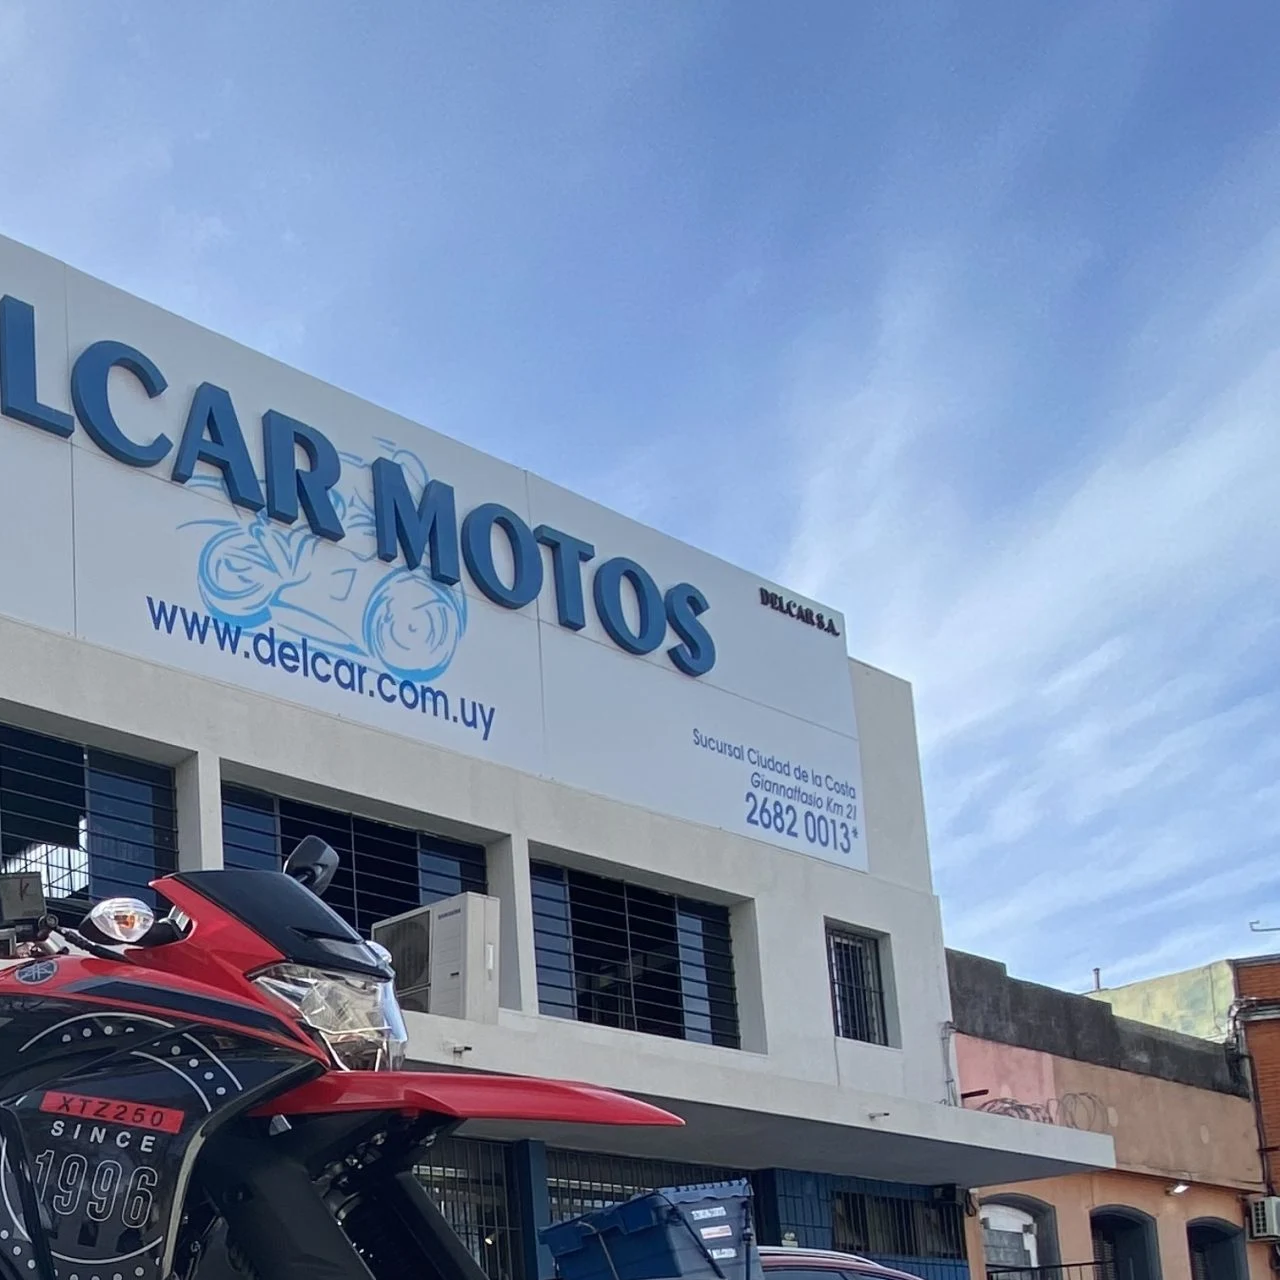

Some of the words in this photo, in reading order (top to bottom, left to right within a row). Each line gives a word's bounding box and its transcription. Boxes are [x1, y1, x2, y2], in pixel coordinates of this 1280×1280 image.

[370, 457, 717, 677] MOTOS
[759, 587, 816, 627] DELCAR
[147, 594, 497, 741] www.delcar.com.uy
[692, 727, 745, 762] Sucursal
[747, 748, 791, 777] Ciudad
[793, 764, 809, 784] de
[811, 769, 822, 788] la
[824, 775, 856, 799] Costa
[745, 791, 799, 838] 2682
[750, 772, 823, 810] Giannattasio
[826, 797, 844, 816] Km
[846, 804, 857, 821] 21
[50, 1120, 157, 1153] SINCE
[57, 1096, 165, 1128] XTZ250
[35, 1148, 159, 1229] 1996
